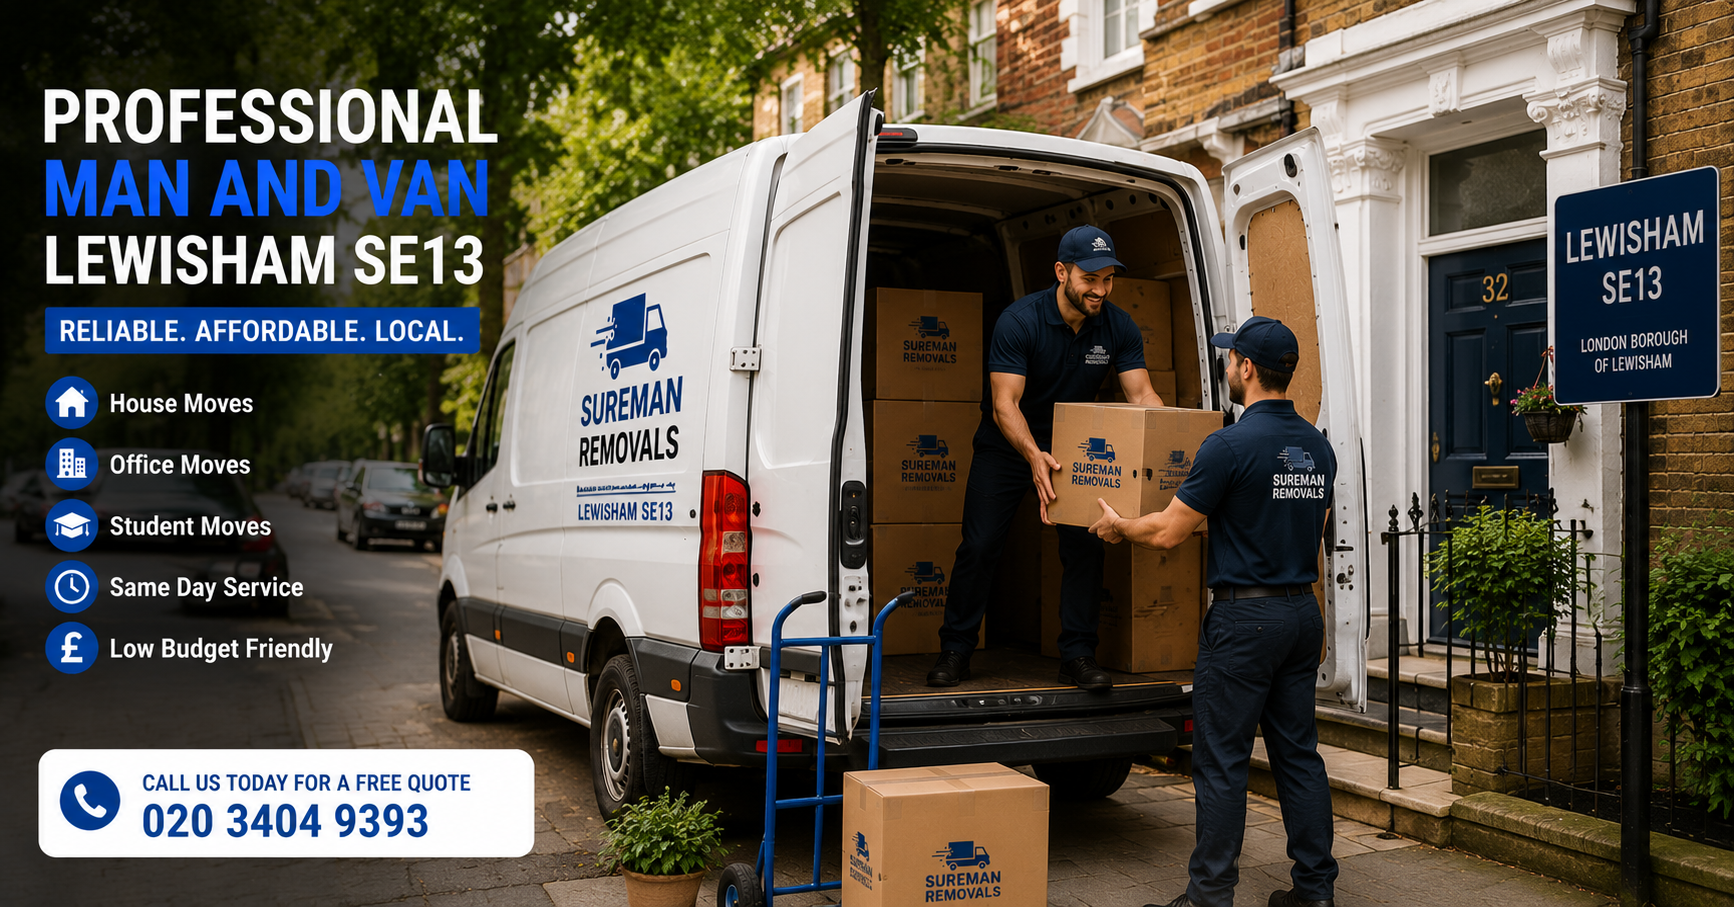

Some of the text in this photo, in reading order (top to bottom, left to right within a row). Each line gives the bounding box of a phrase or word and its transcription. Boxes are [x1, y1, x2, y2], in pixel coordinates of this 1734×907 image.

[1566, 209, 1704, 264] LEWISHAM
[1482, 273, 1509, 304] 32
[1602, 266, 1662, 305] SE13
[903, 340, 957, 352] SUREMAN
[1581, 329, 1688, 353] LONDON BOROUGH
[903, 352, 957, 364] REMOVALS
[1594, 353, 1672, 373] OF LEWISHAM
[581, 375, 683, 427] SUREMAN
[579, 425, 680, 467] REMOVALS
[901, 460, 956, 471] SUREMAN
[1072, 462, 1122, 477] SUREMAN
[901, 472, 956, 483] REMOVALS
[1071, 474, 1121, 489] REMOVALS
[1273, 473, 1325, 487] SUREMAN
[1272, 487, 1325, 499] REMOVALS
[578, 501, 673, 521] LEWISHAM SE13
[925, 871, 1001, 888] SUREMAN
[925, 886, 1001, 903] REMOVALS
